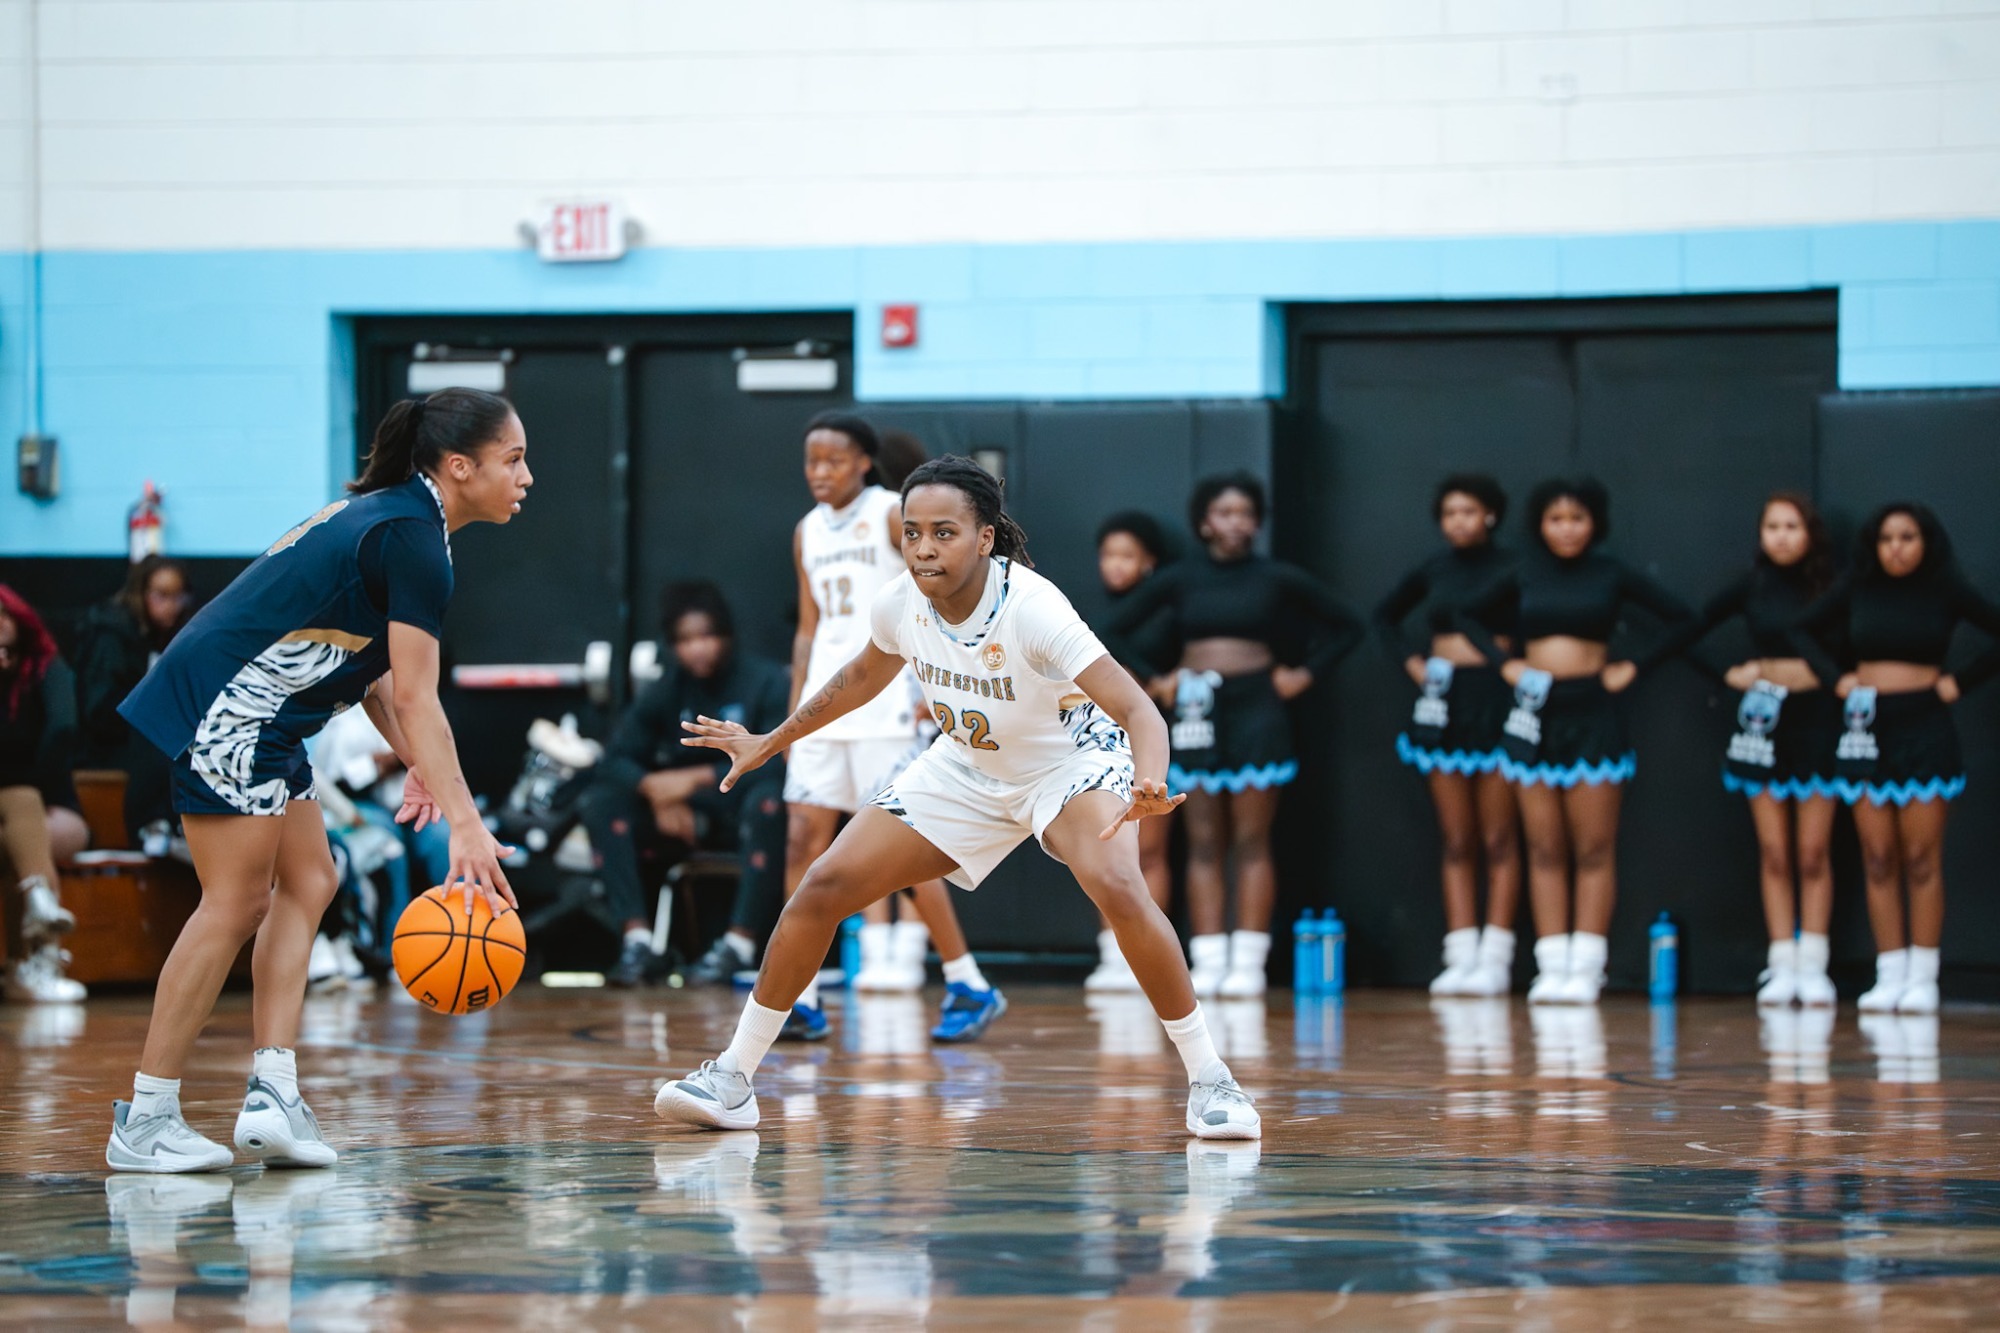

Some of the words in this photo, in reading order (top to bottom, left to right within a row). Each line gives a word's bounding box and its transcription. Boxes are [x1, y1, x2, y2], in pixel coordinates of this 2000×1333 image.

[554, 203, 610, 252] EXIT
[821, 575, 854, 618] 12
[913, 656, 1017, 701] LIVINGSTONE
[987, 651, 1003, 664] 50
[933, 699, 1000, 751] 22
